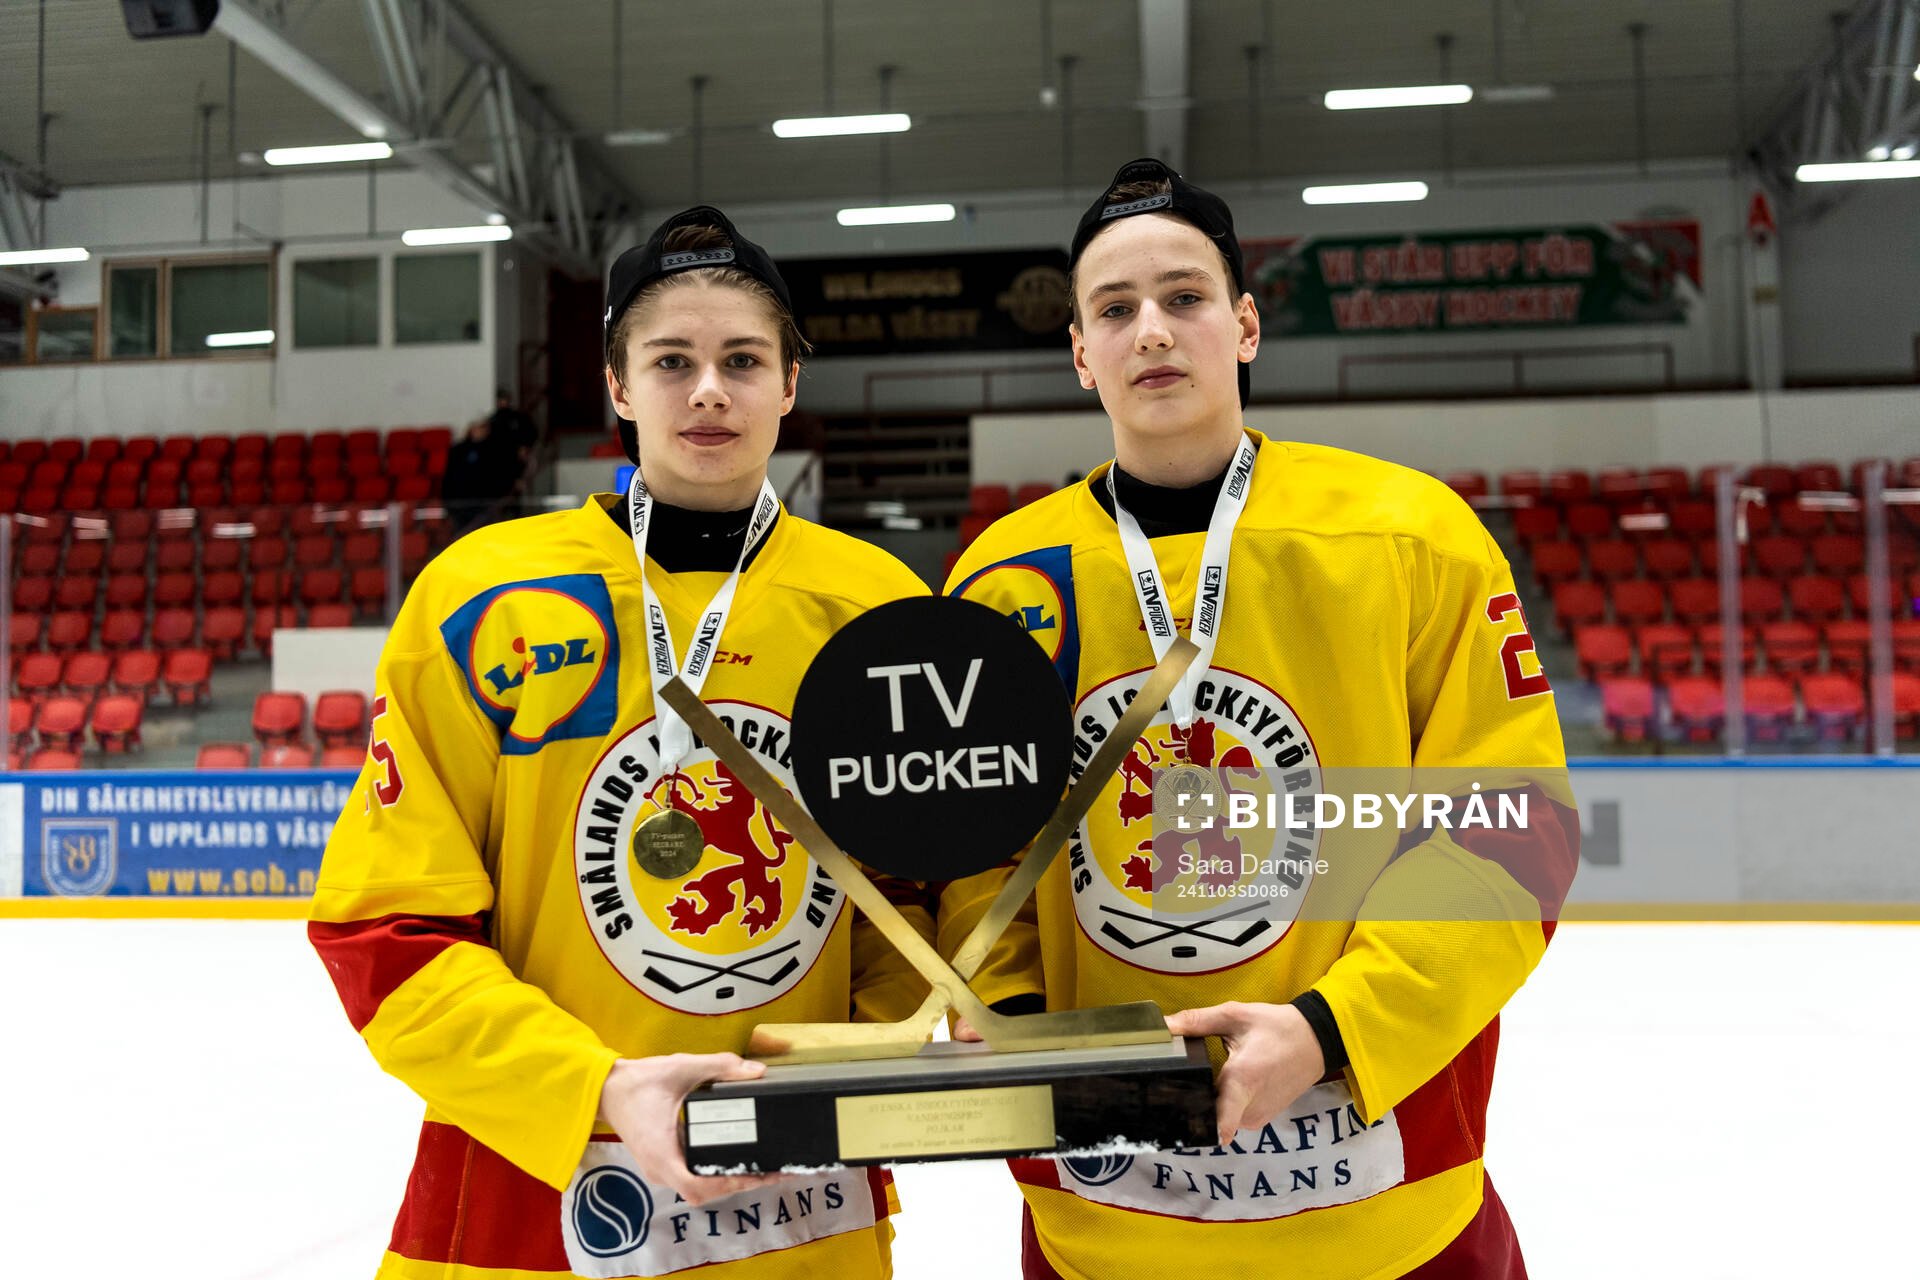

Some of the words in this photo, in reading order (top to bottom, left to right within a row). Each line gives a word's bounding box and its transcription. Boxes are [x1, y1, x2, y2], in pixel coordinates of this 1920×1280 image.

[866, 658, 983, 732] TV
[828, 742, 1039, 799] PUCKEN
[41, 787, 78, 813] DIN
[149, 821, 268, 848] UPPLANDS
[276, 816, 335, 848] VÄSB
[580, 755, 649, 940] SMÅLANDS
[147, 862, 319, 894] www.sob.n
[670, 1182, 844, 1244] FINANS
